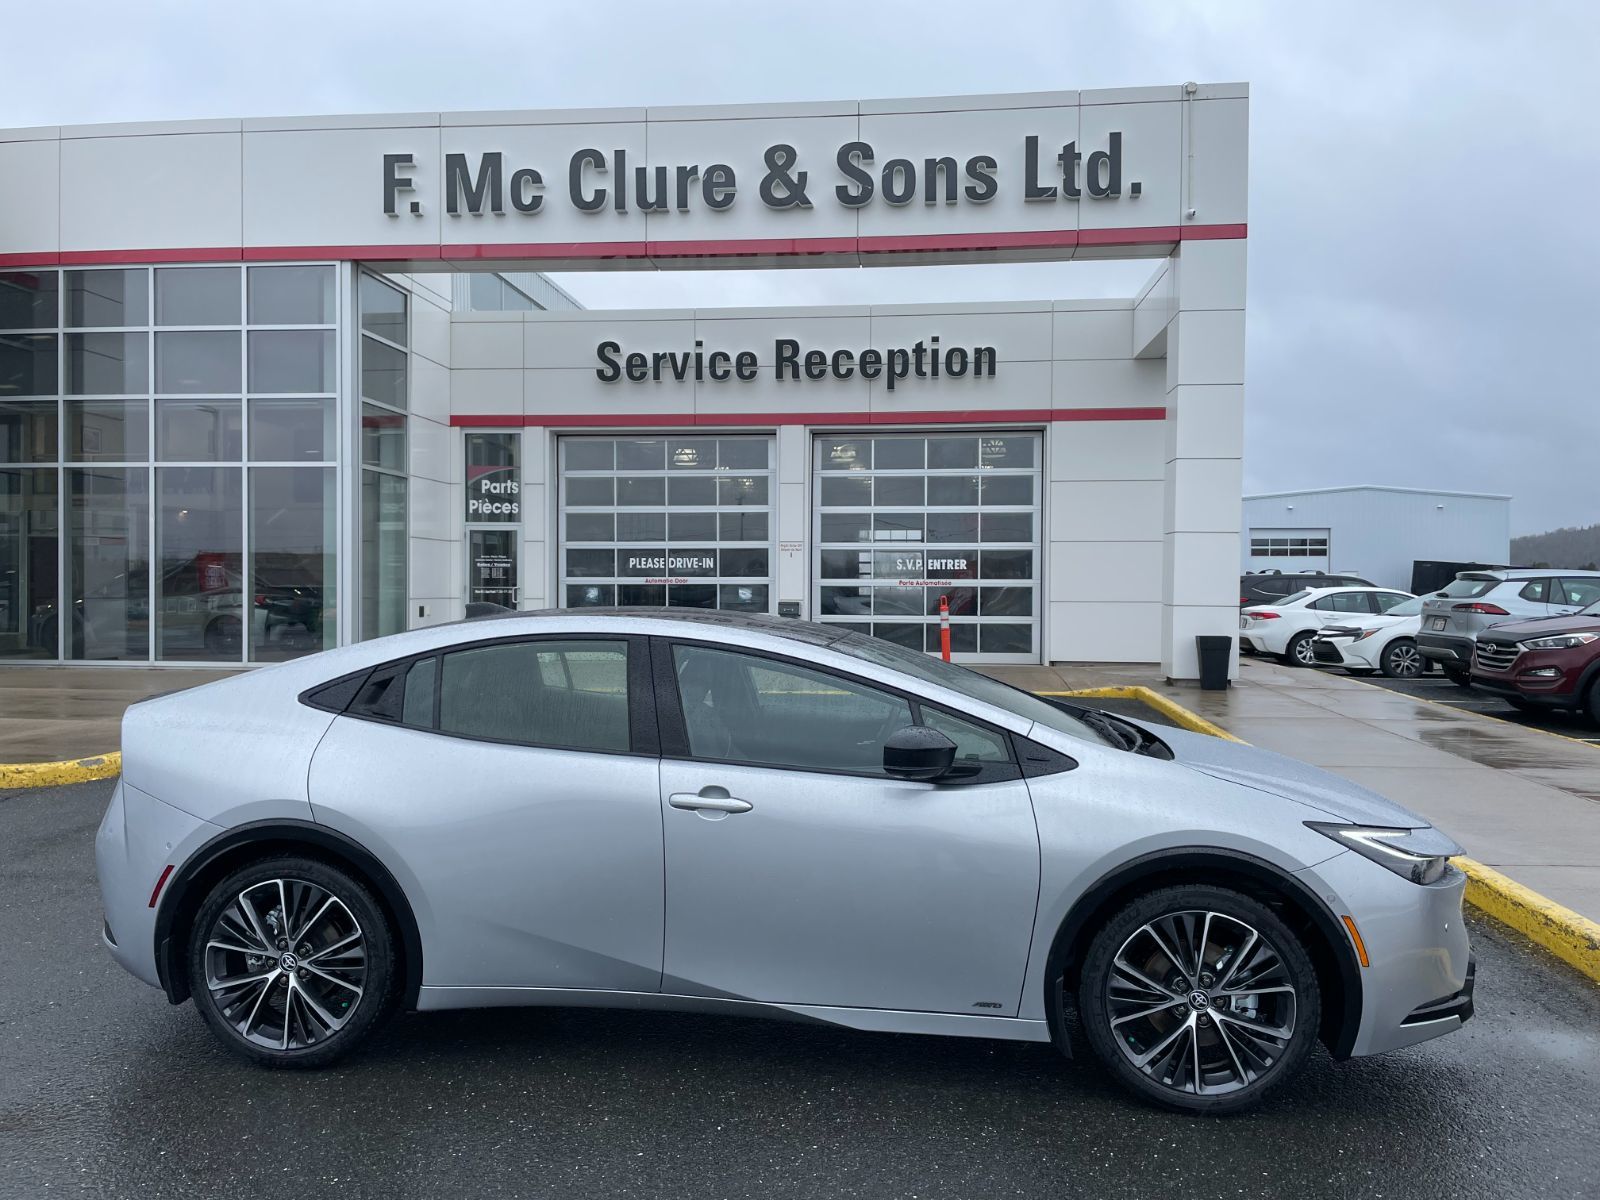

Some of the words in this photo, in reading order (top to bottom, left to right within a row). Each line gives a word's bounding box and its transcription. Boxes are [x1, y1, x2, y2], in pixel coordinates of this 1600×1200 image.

[383, 153, 422, 215] F.
[445, 151, 544, 216] Mc
[568, 148, 737, 214] Clure
[759, 144, 814, 209] &
[835, 141, 999, 208] Sons
[1024, 132, 1142, 203] Ltd.
[596, 340, 759, 383] Service
[774, 335, 998, 391] Reception
[481, 479, 519, 494] Parts
[469, 498, 519, 514] Pièces
[629, 557, 665, 569] PLEASE
[668, 557, 714, 569] DRIVE-IN
[896, 559, 924, 570] S.V.P.
[927, 559, 967, 570] ENTRER
